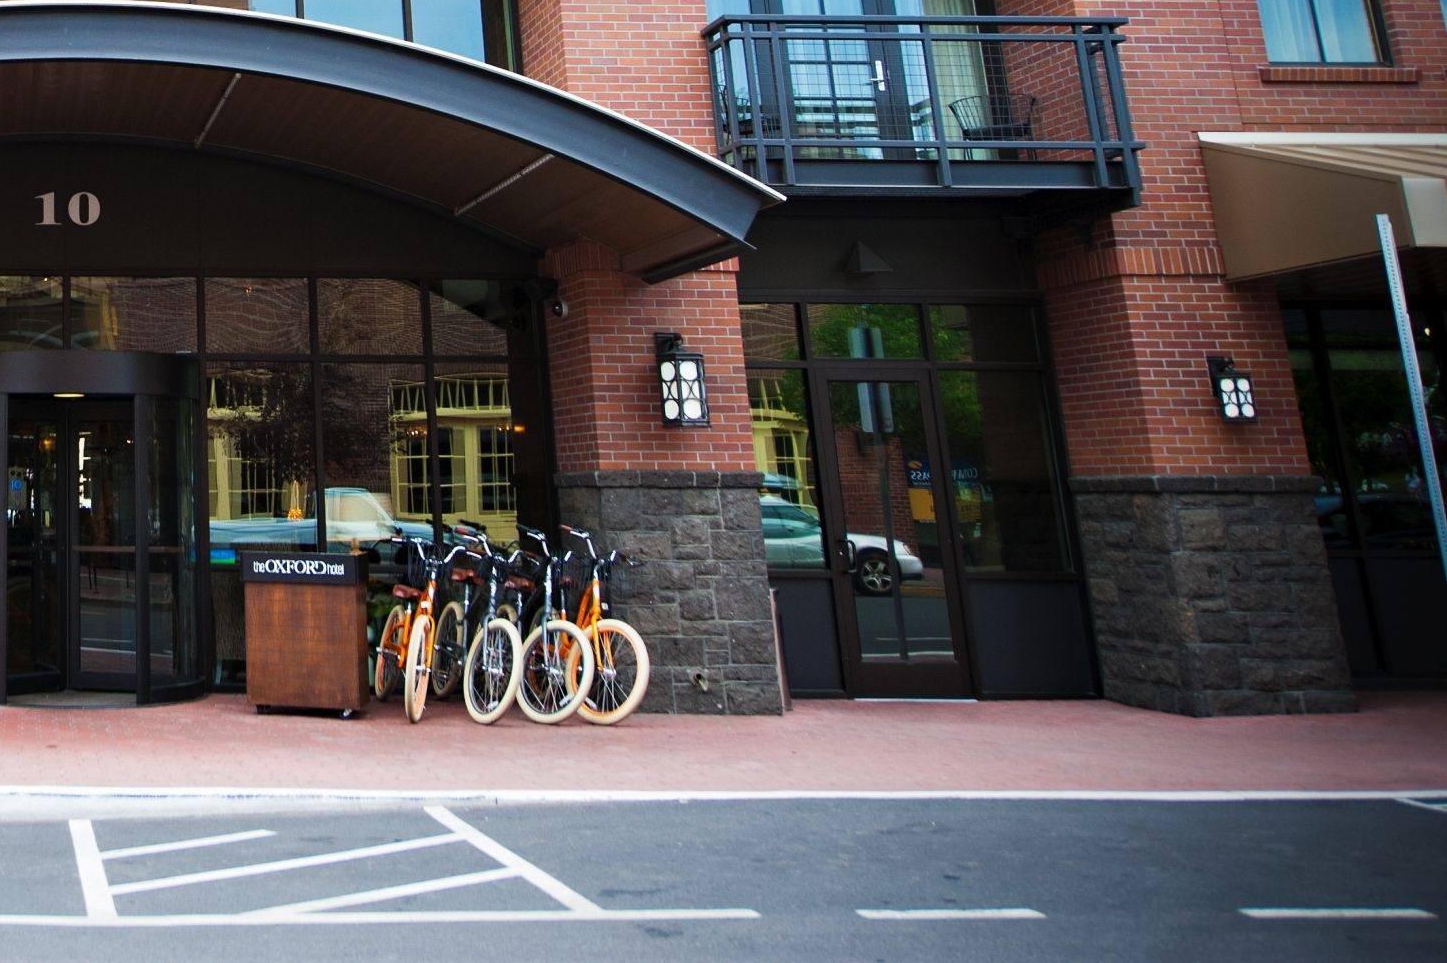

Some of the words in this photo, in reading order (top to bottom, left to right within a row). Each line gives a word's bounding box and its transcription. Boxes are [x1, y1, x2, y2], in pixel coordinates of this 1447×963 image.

[34, 191, 101, 226] 10
[253, 561, 265, 573] the
[264, 559, 327, 575] OXFORD
[326, 563, 345, 576] hotel
